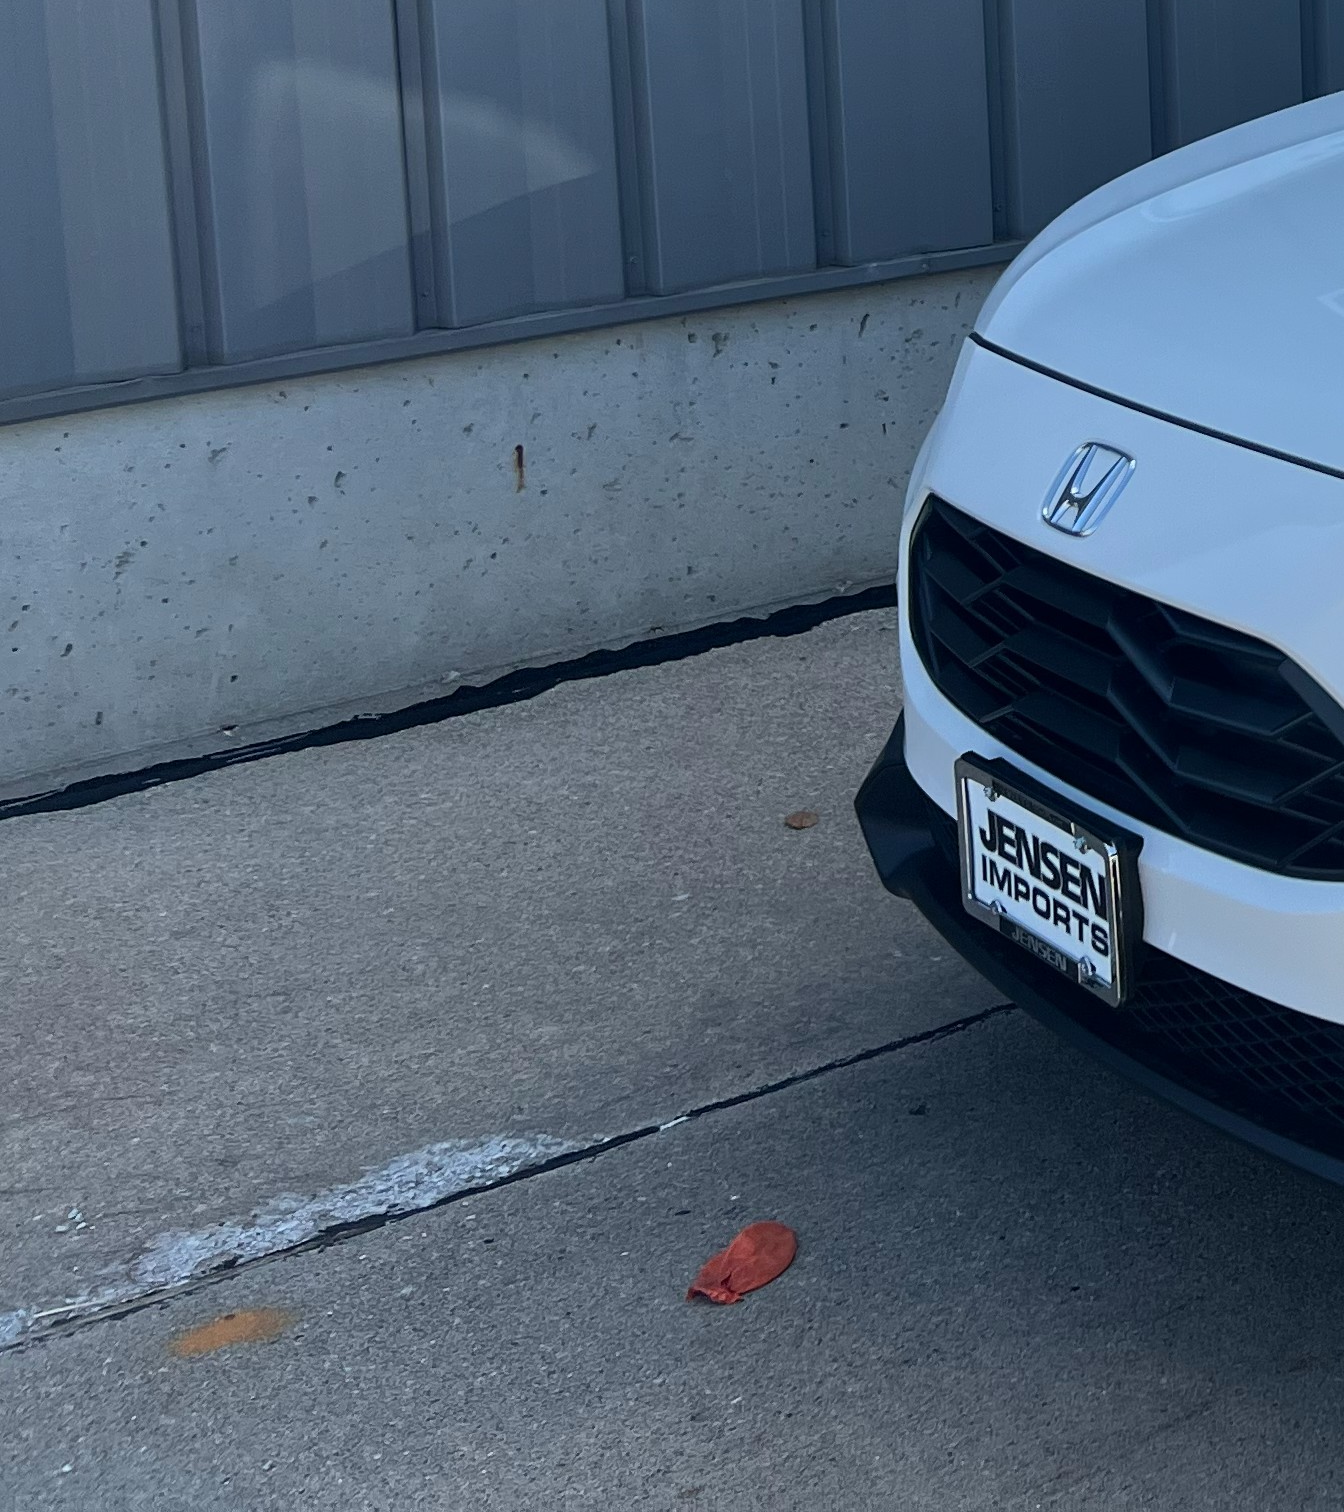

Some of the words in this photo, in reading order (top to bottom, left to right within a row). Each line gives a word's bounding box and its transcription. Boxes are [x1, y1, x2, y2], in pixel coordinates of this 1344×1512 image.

[978, 808, 1107, 921] JENSEN
[981, 854, 1109, 958] IMPORTS
[1011, 926, 1067, 972] JENSEN
